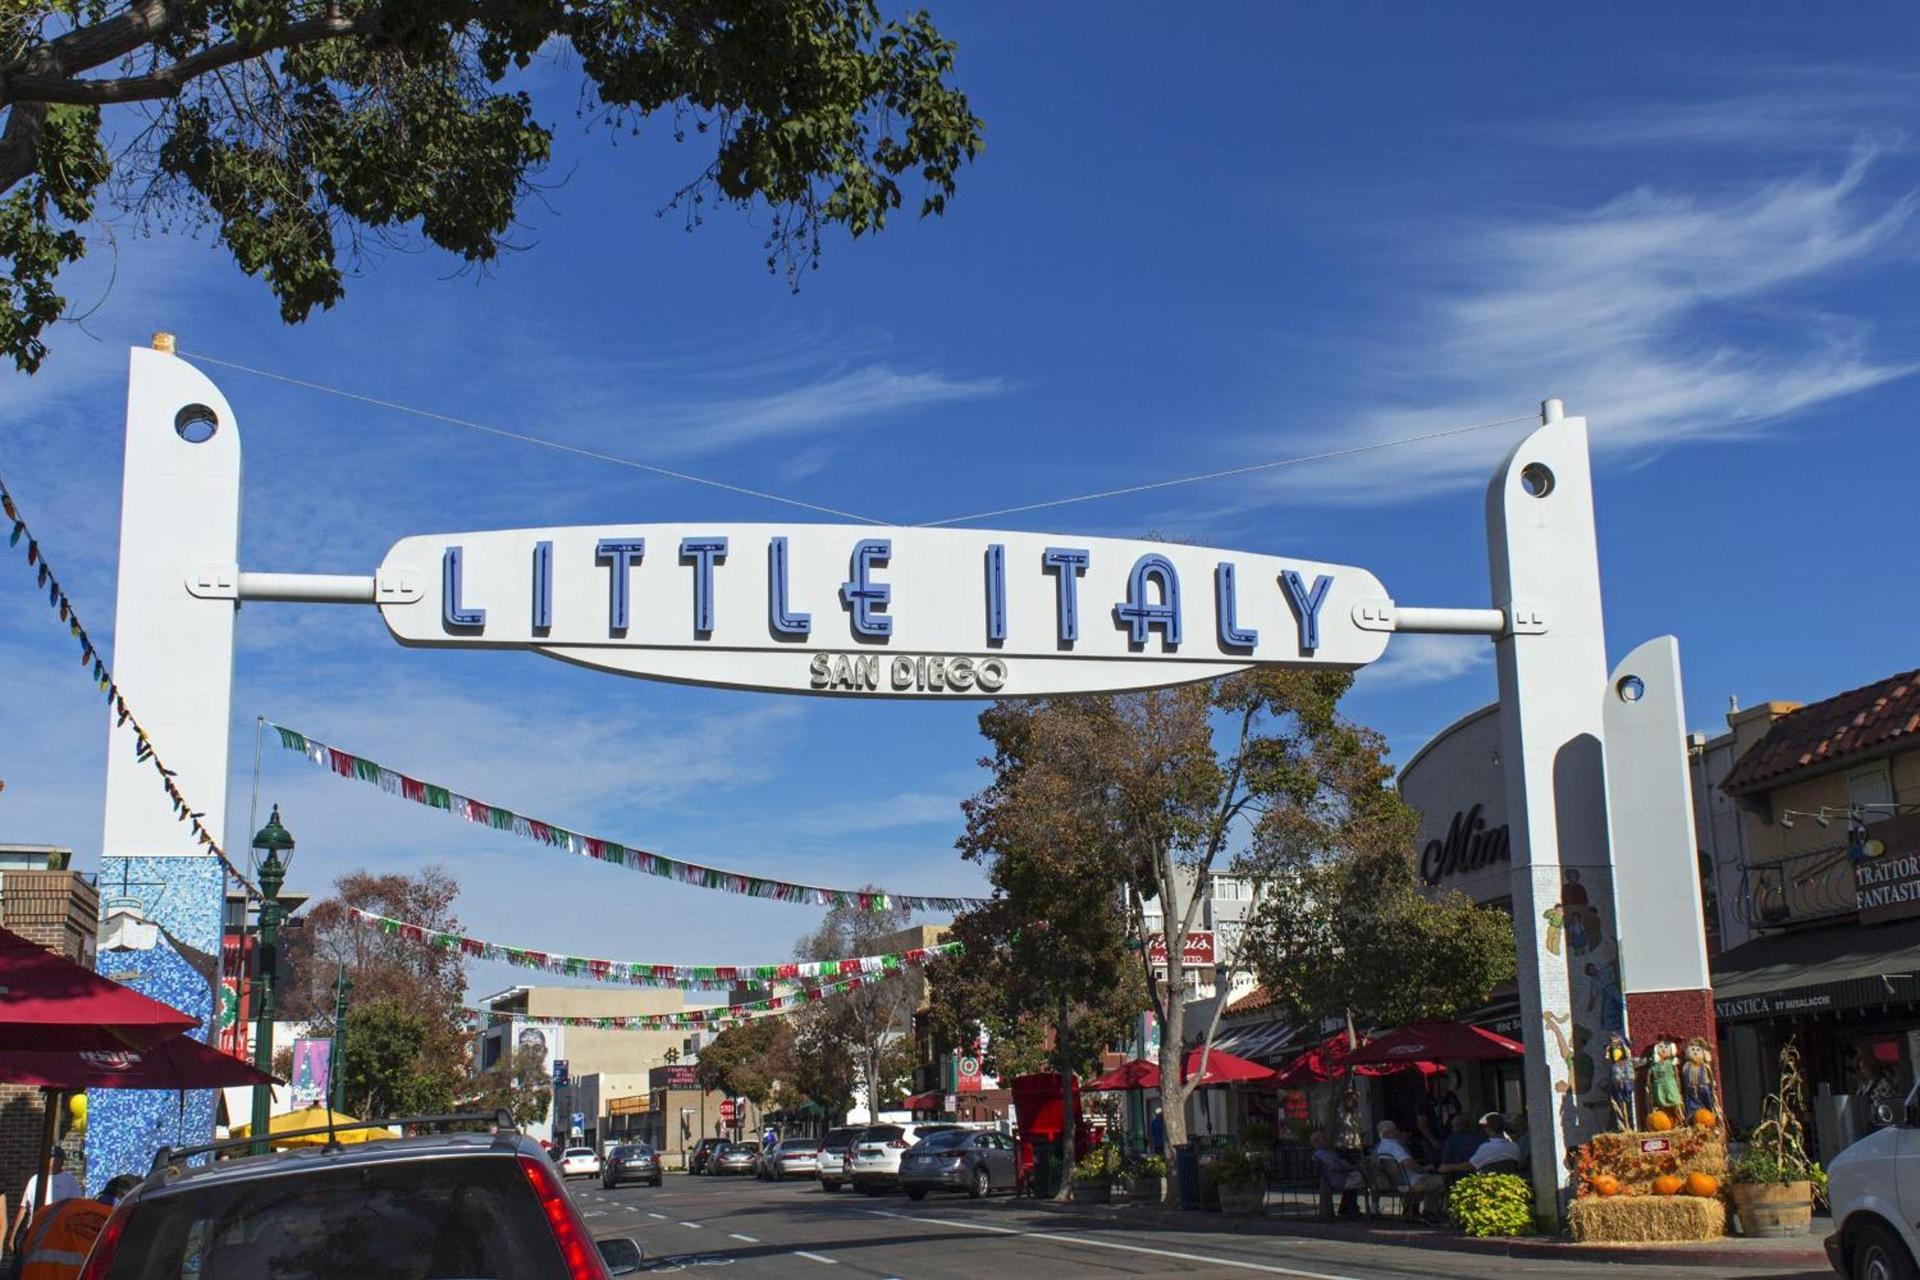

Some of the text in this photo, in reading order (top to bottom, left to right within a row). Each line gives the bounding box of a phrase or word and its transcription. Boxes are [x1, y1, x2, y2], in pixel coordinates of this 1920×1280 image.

[443, 536, 1335, 650] LITTLE ITALY
[810, 652, 1008, 693] SAN DIEGO
